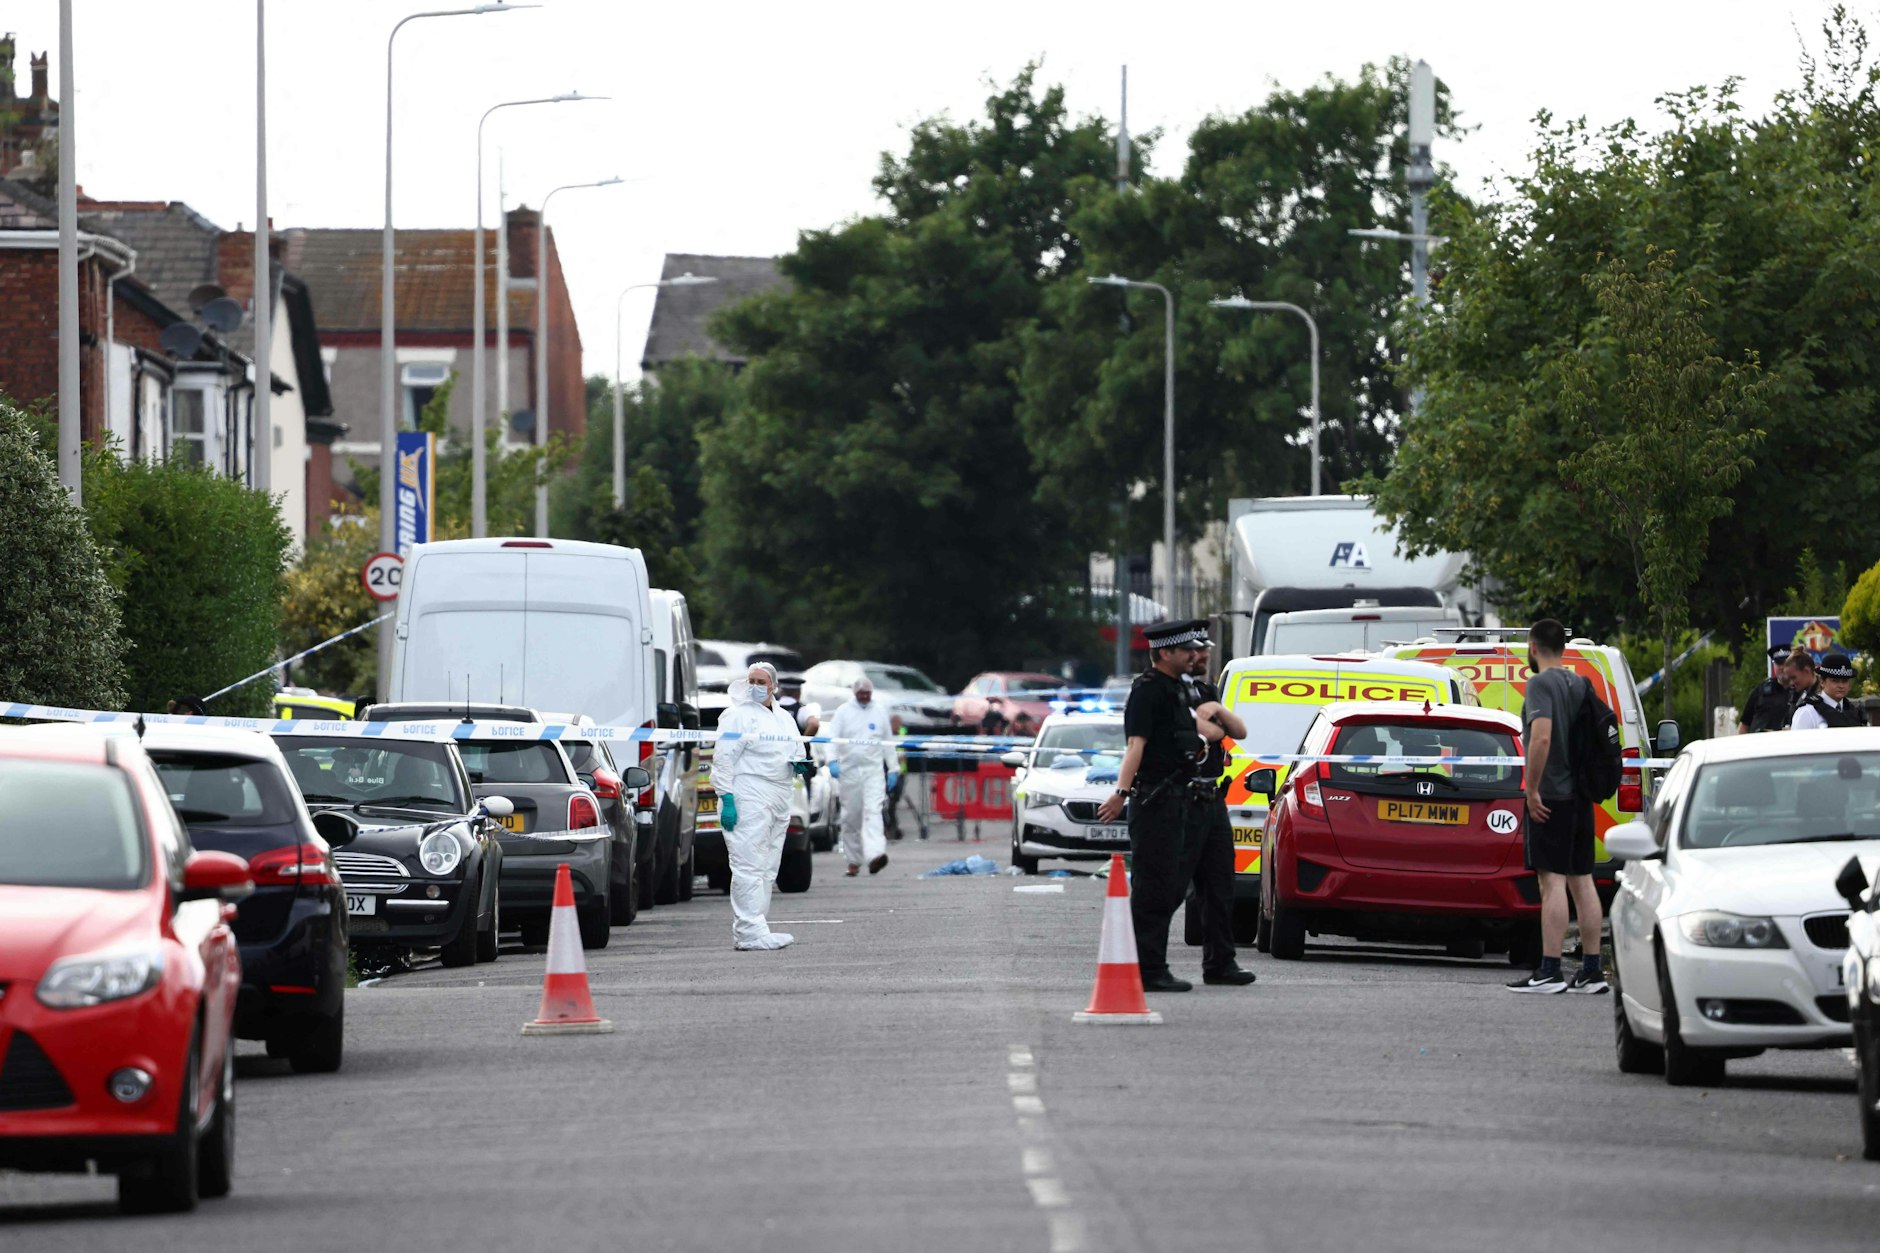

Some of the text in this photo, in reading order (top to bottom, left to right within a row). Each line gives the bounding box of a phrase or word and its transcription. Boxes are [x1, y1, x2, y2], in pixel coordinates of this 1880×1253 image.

[397, 487, 417, 560] RING
[1457, 665, 1533, 681] OLIC
[1250, 681, 1427, 701] POLICE
[1387, 802, 1459, 821] PL17 MWW
[1490, 813, 1513, 830] UK
[1090, 827, 1117, 838] DK70
[1234, 828, 1262, 843] DK6
[347, 896, 365, 911] DX
